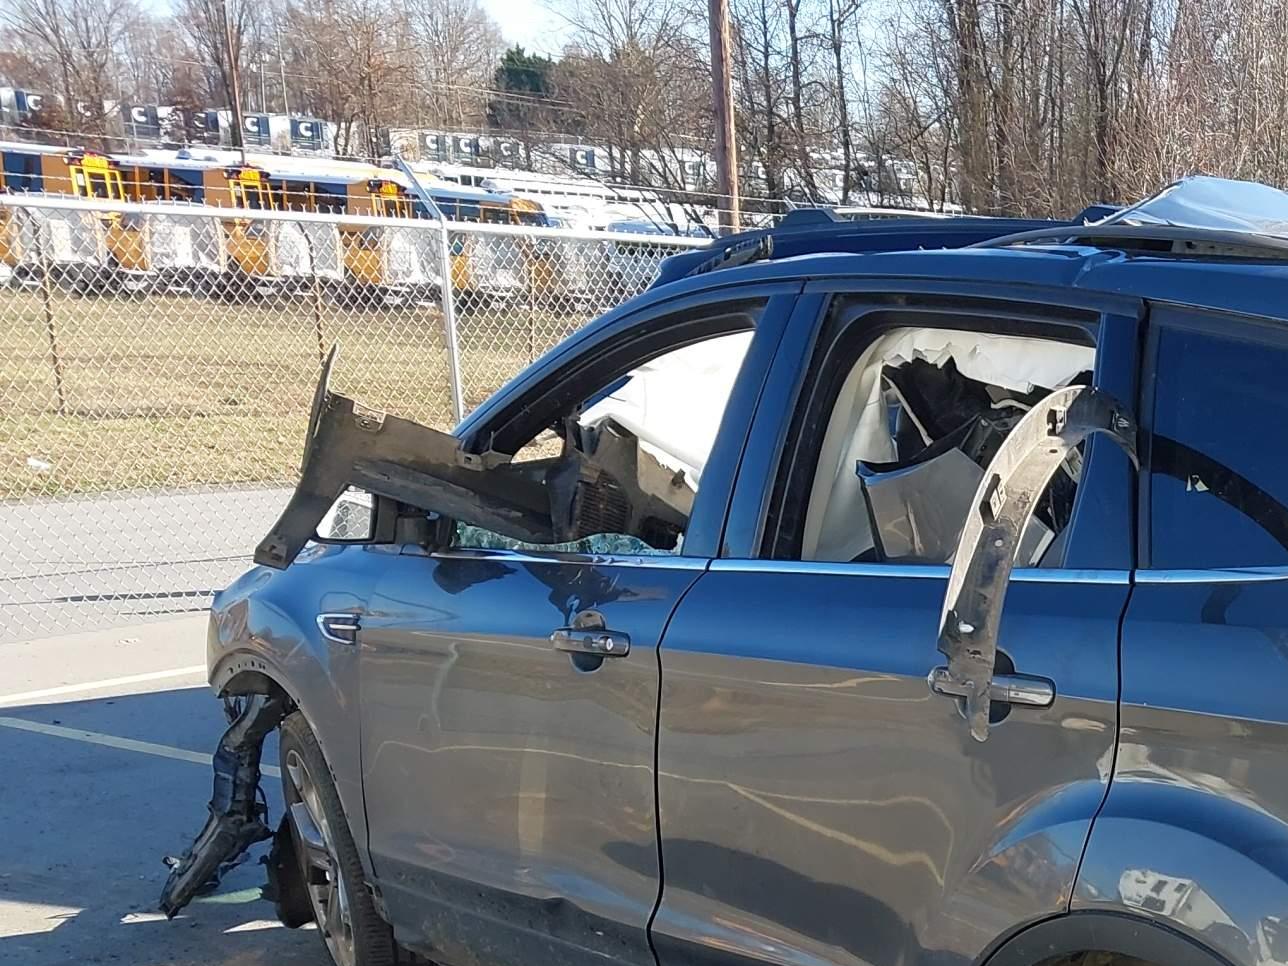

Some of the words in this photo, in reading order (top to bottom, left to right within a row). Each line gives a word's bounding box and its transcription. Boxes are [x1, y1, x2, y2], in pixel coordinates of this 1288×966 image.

[27, 95, 42, 110] C
[132, 107, 147, 122] C
[245, 118, 258, 132] C
[299, 122, 313, 137] C
[425, 135, 437, 149] C
[459, 138, 471, 152] C
[575, 151, 587, 164] C
